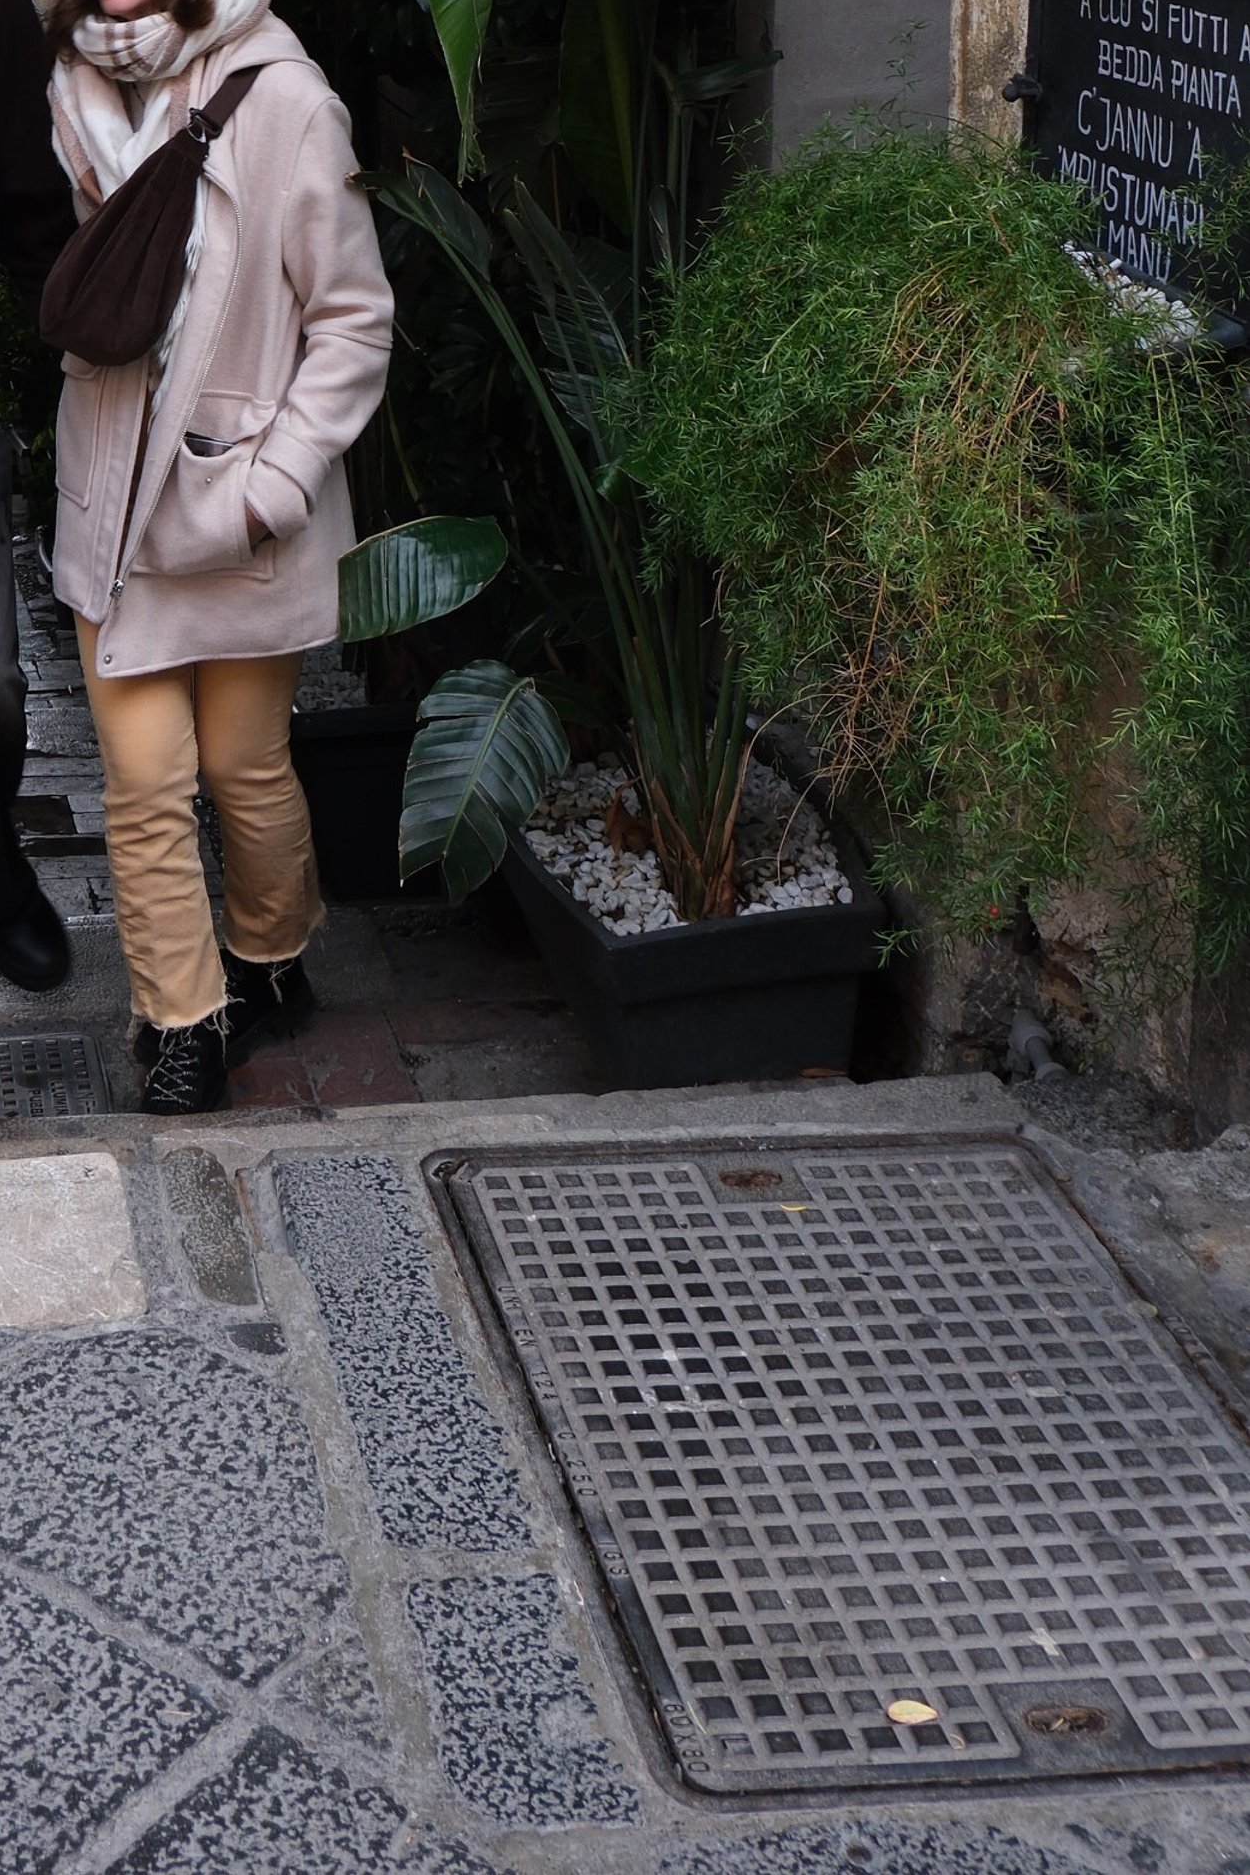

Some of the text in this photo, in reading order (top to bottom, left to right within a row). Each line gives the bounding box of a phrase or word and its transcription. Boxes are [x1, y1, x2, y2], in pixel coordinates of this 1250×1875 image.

[1168, 4, 1228, 56] FUTTI
[1097, 38, 1242, 119] BEDDA PIANTA
[1107, 219, 1171, 284] MANU
[567, 1459, 597, 1496] 250
